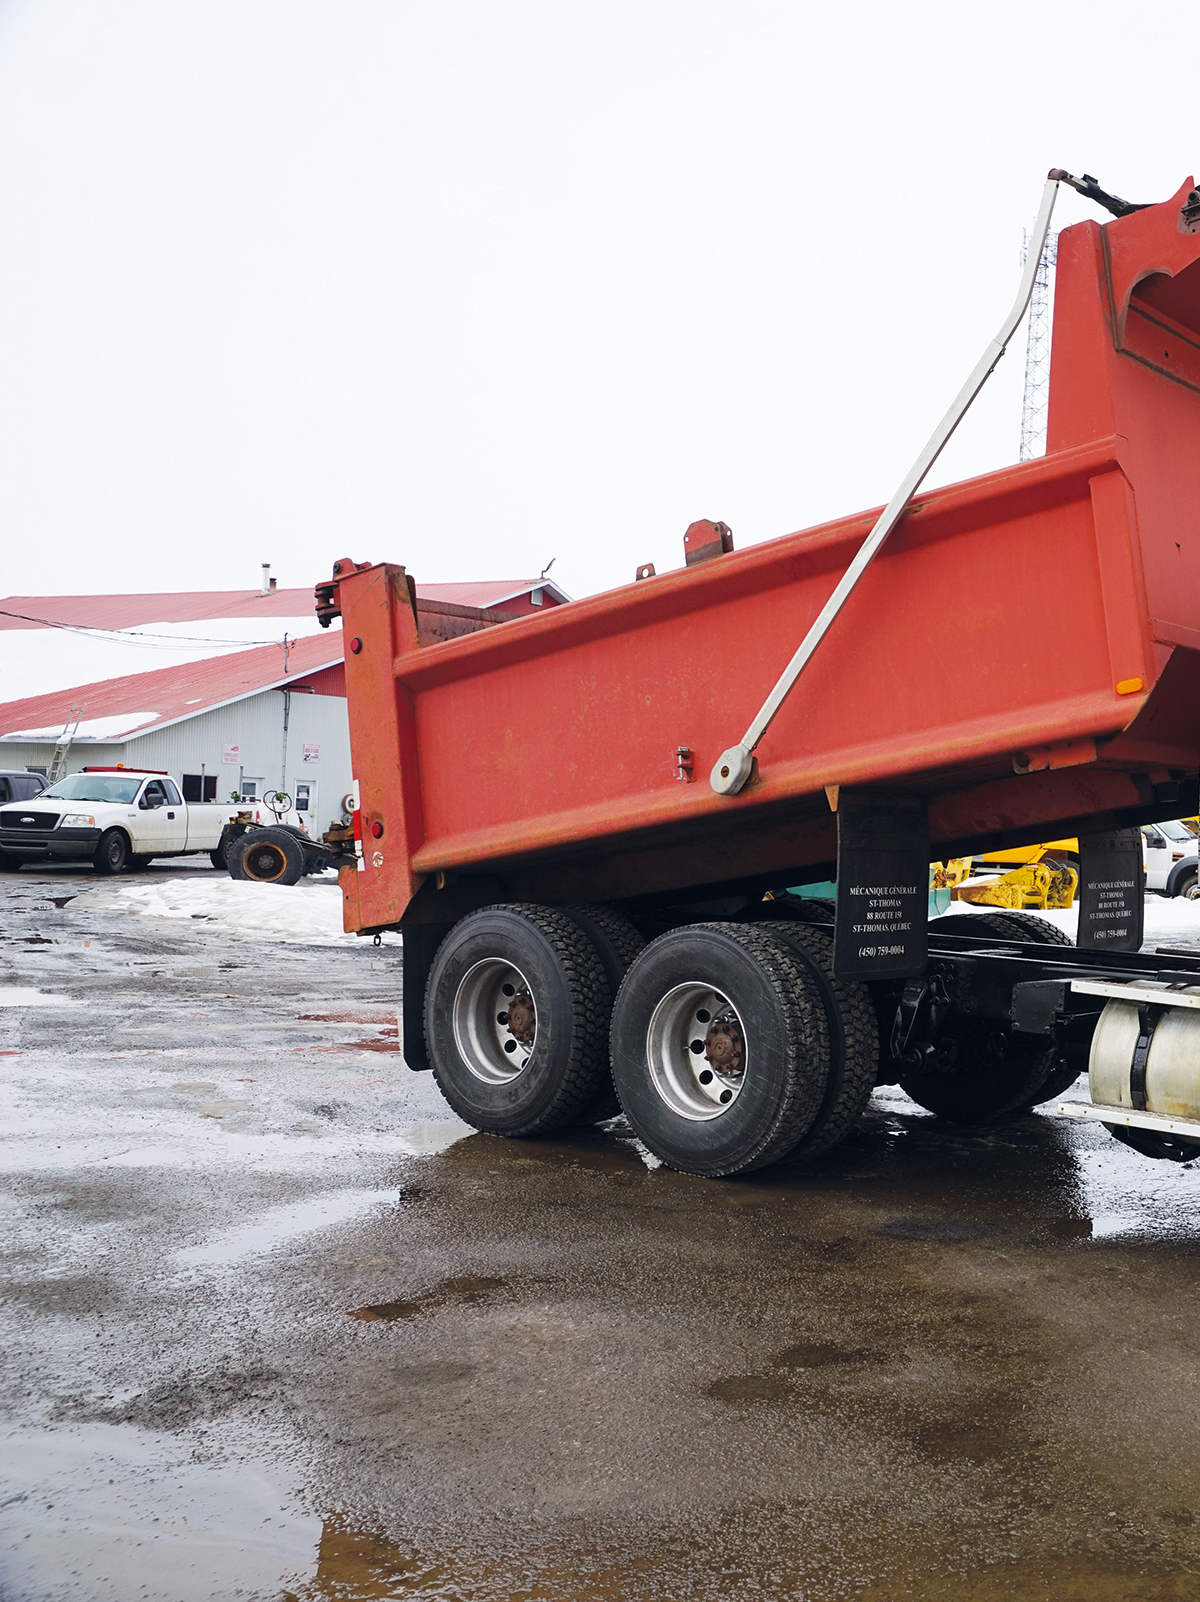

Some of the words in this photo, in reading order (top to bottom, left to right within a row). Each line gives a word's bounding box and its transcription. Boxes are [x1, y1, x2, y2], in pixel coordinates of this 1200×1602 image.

[849, 885, 888, 896] MÉCANIQUE
[889, 885, 918, 895] GÉNÉRALE
[869, 899, 902, 908] ST-THOMAS
[866, 911, 874, 920] 88
[874, 911, 894, 920] ROUTE
[890, 921, 912, 933] QUÉBEC
[858, 946, 876, 958] (450)
[877, 945, 905, 956] 759-0004
